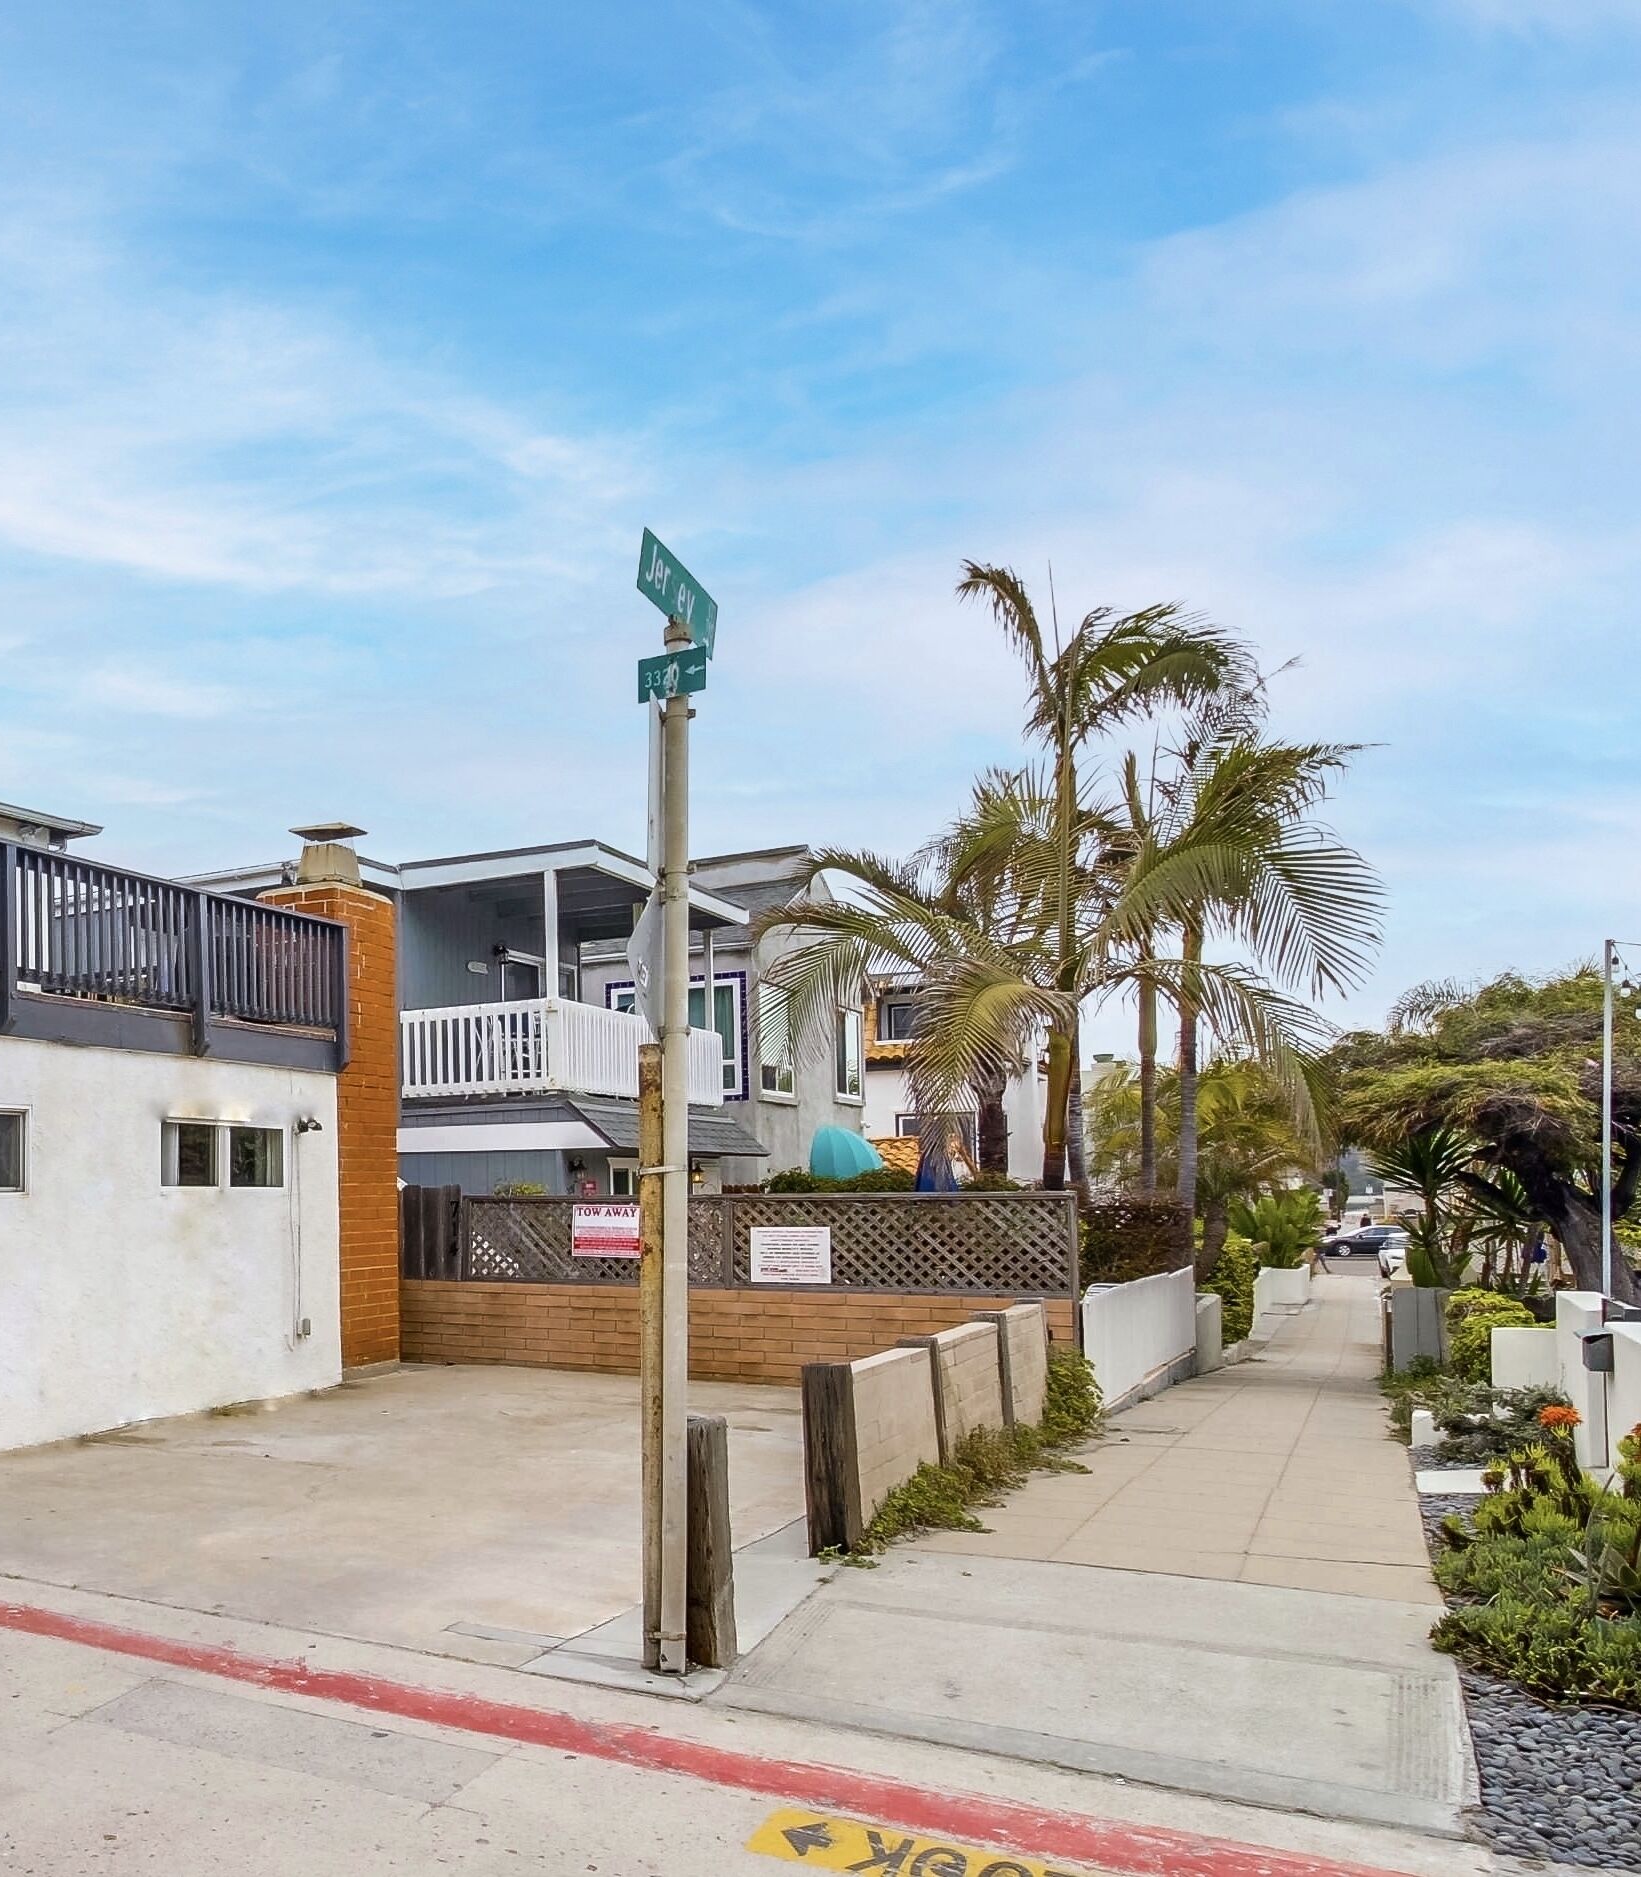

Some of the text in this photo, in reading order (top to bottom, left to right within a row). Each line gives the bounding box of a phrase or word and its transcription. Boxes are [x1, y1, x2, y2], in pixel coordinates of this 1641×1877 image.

[645, 543, 696, 625] Jerey
[576, 1207, 637, 1218] TOW AWAY
